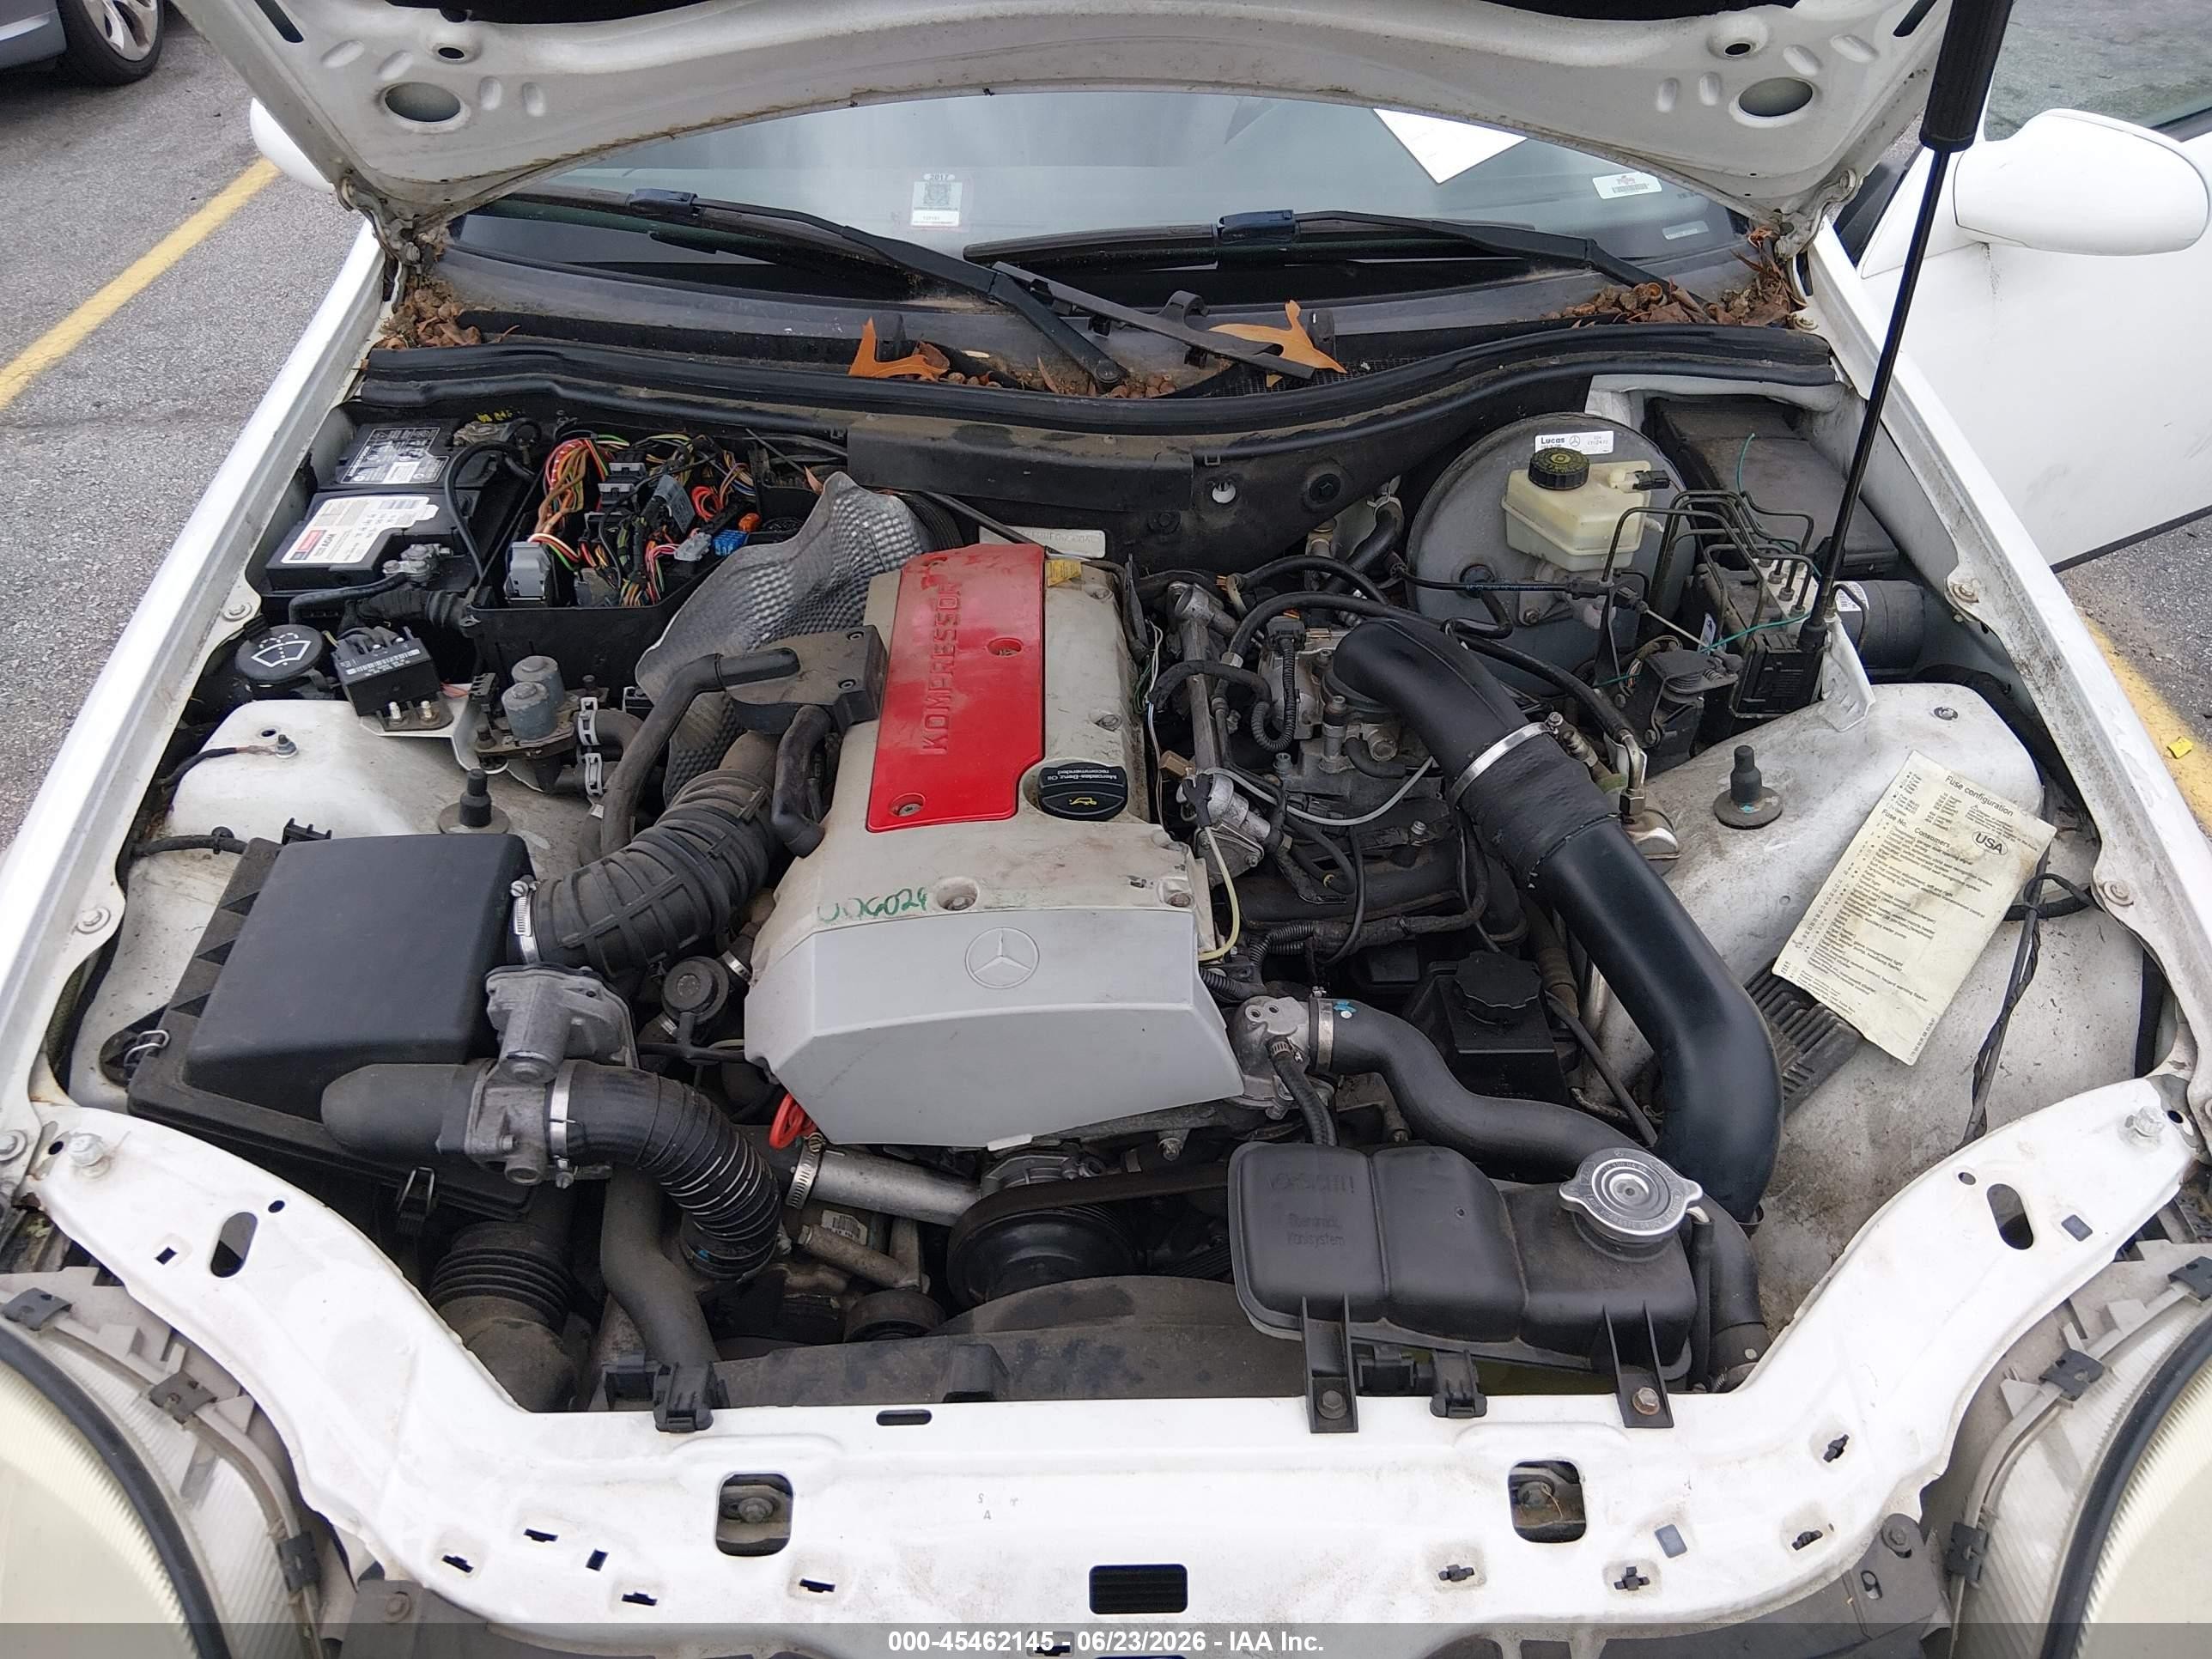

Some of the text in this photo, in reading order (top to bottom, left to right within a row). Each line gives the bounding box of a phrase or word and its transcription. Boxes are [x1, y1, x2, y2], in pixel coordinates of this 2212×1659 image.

[1540, 436, 1565, 445] Lucas
[921, 580, 962, 755] KOMPRESSOR
[1944, 775, 1965, 792] Fuse
[1965, 786, 2014, 818] configuration
[1881, 809, 1897, 822] Fuse
[1897, 818, 1909, 828] No.
[1974, 831, 2006, 854] USA
